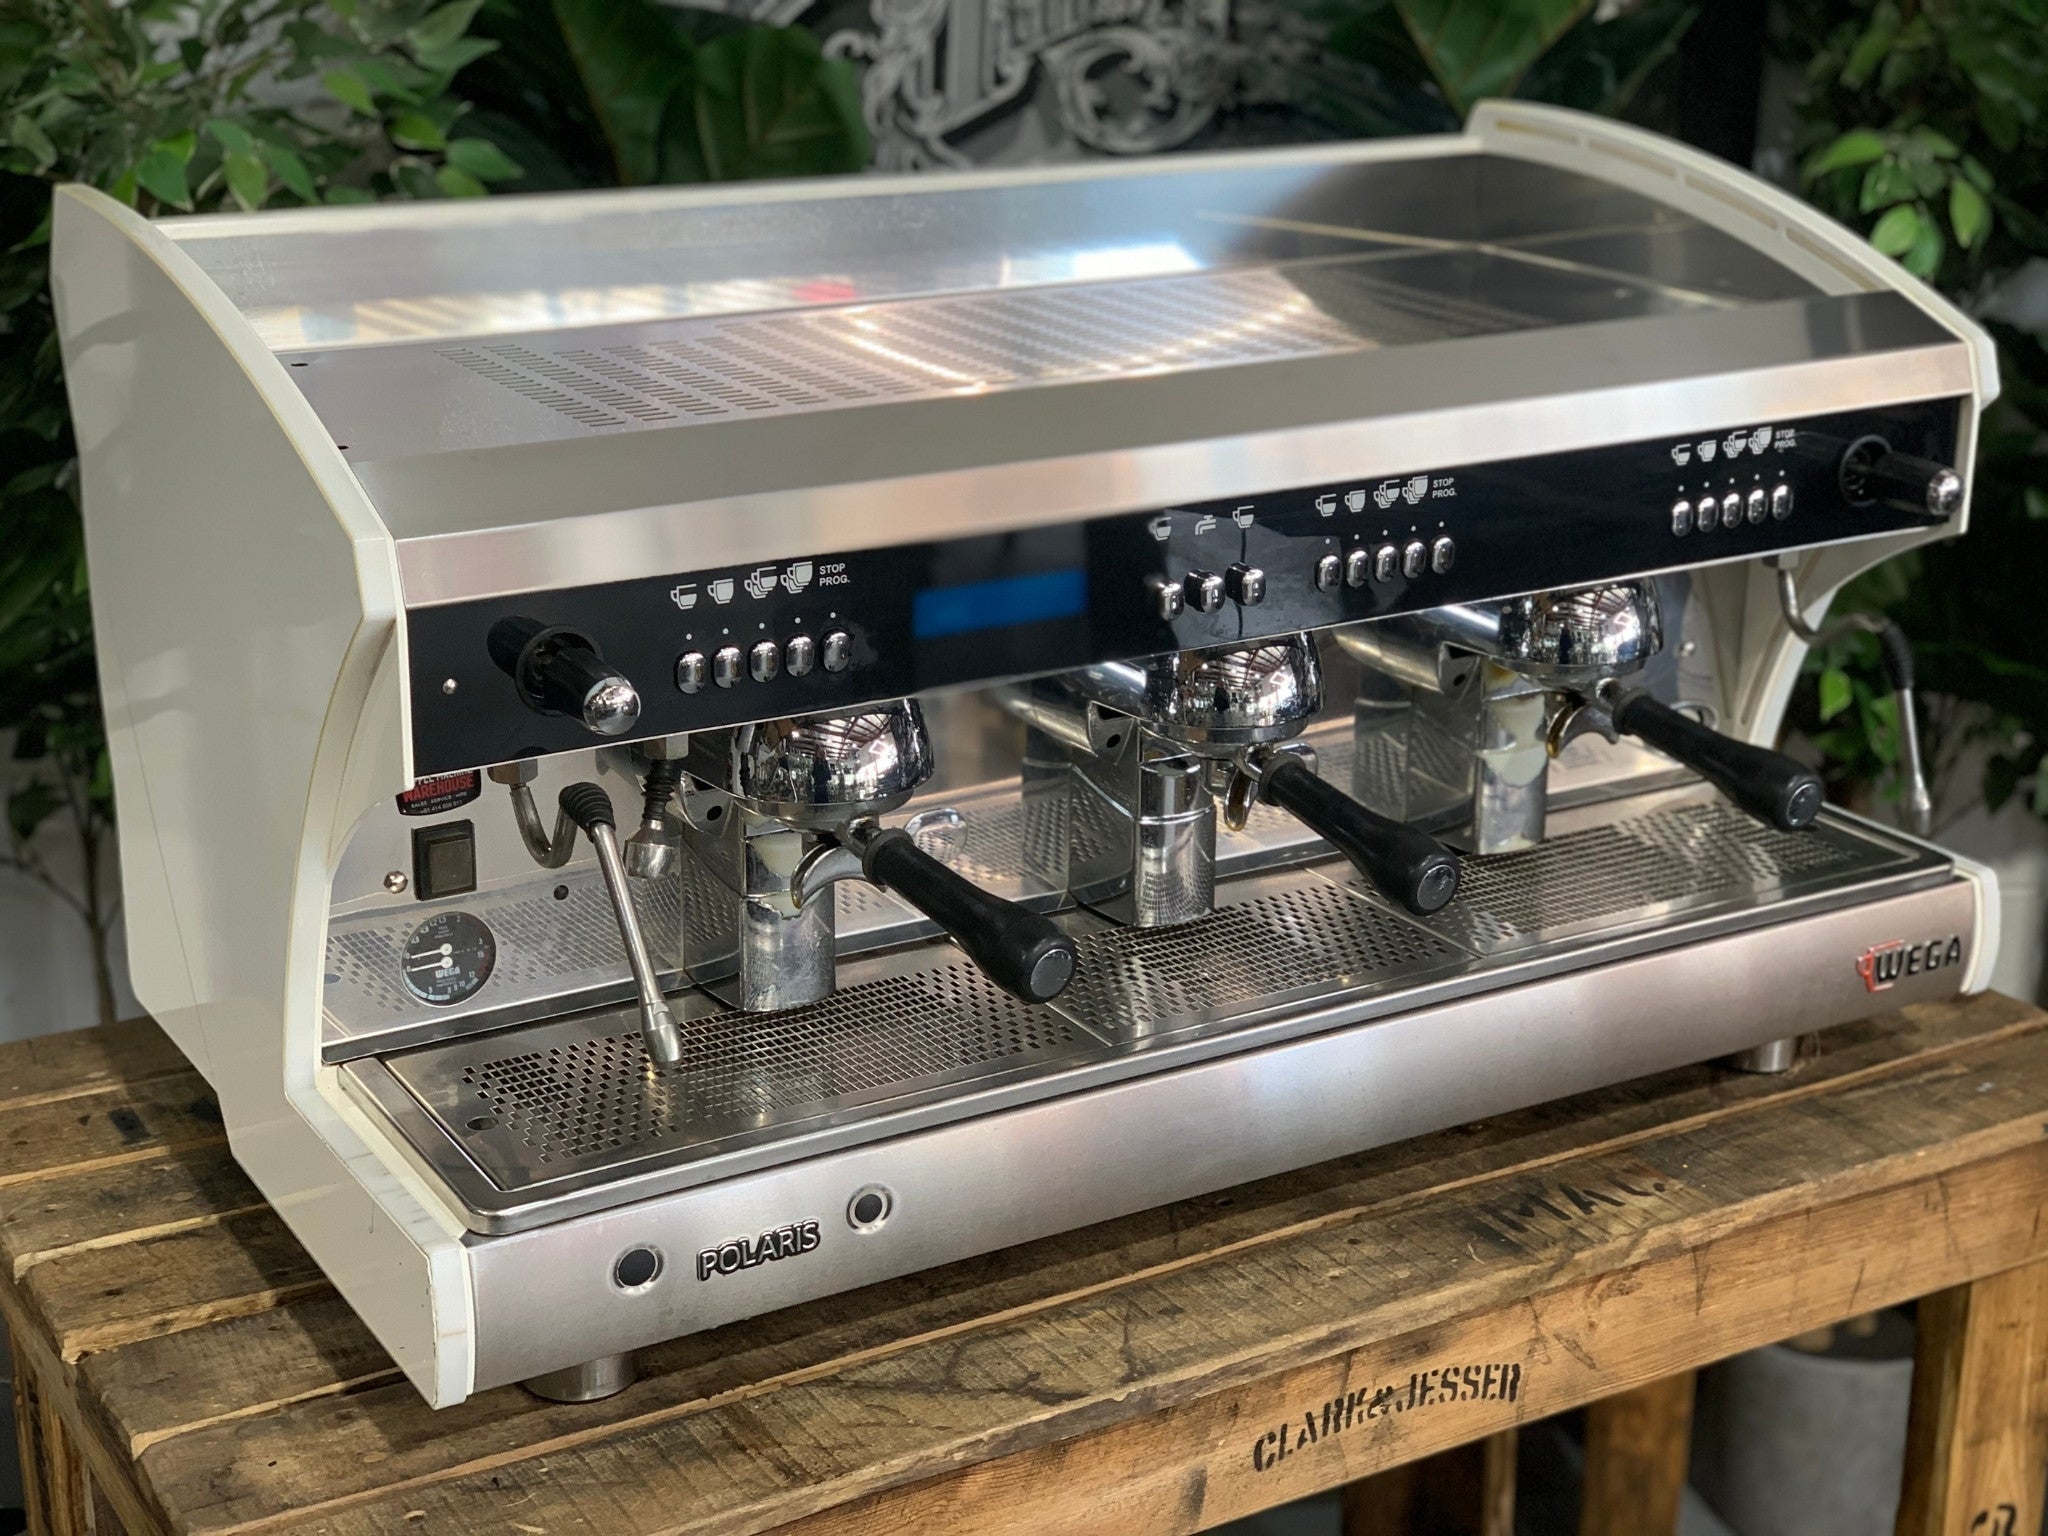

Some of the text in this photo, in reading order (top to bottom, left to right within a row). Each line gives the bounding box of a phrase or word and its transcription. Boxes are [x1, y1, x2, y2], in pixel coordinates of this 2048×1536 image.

[1433, 478, 1454, 488] STOP
[1431, 488, 1457, 499] PROG.
[819, 563, 846, 575] STOP
[819, 574, 850, 587] PROG.
[403, 774, 475, 803] WAREHOUSE
[411, 801, 428, 809] SALES
[1875, 934, 1961, 983] WEGA
[435, 966, 460, 979] WEGA
[697, 1218, 820, 1281] POLARIS
